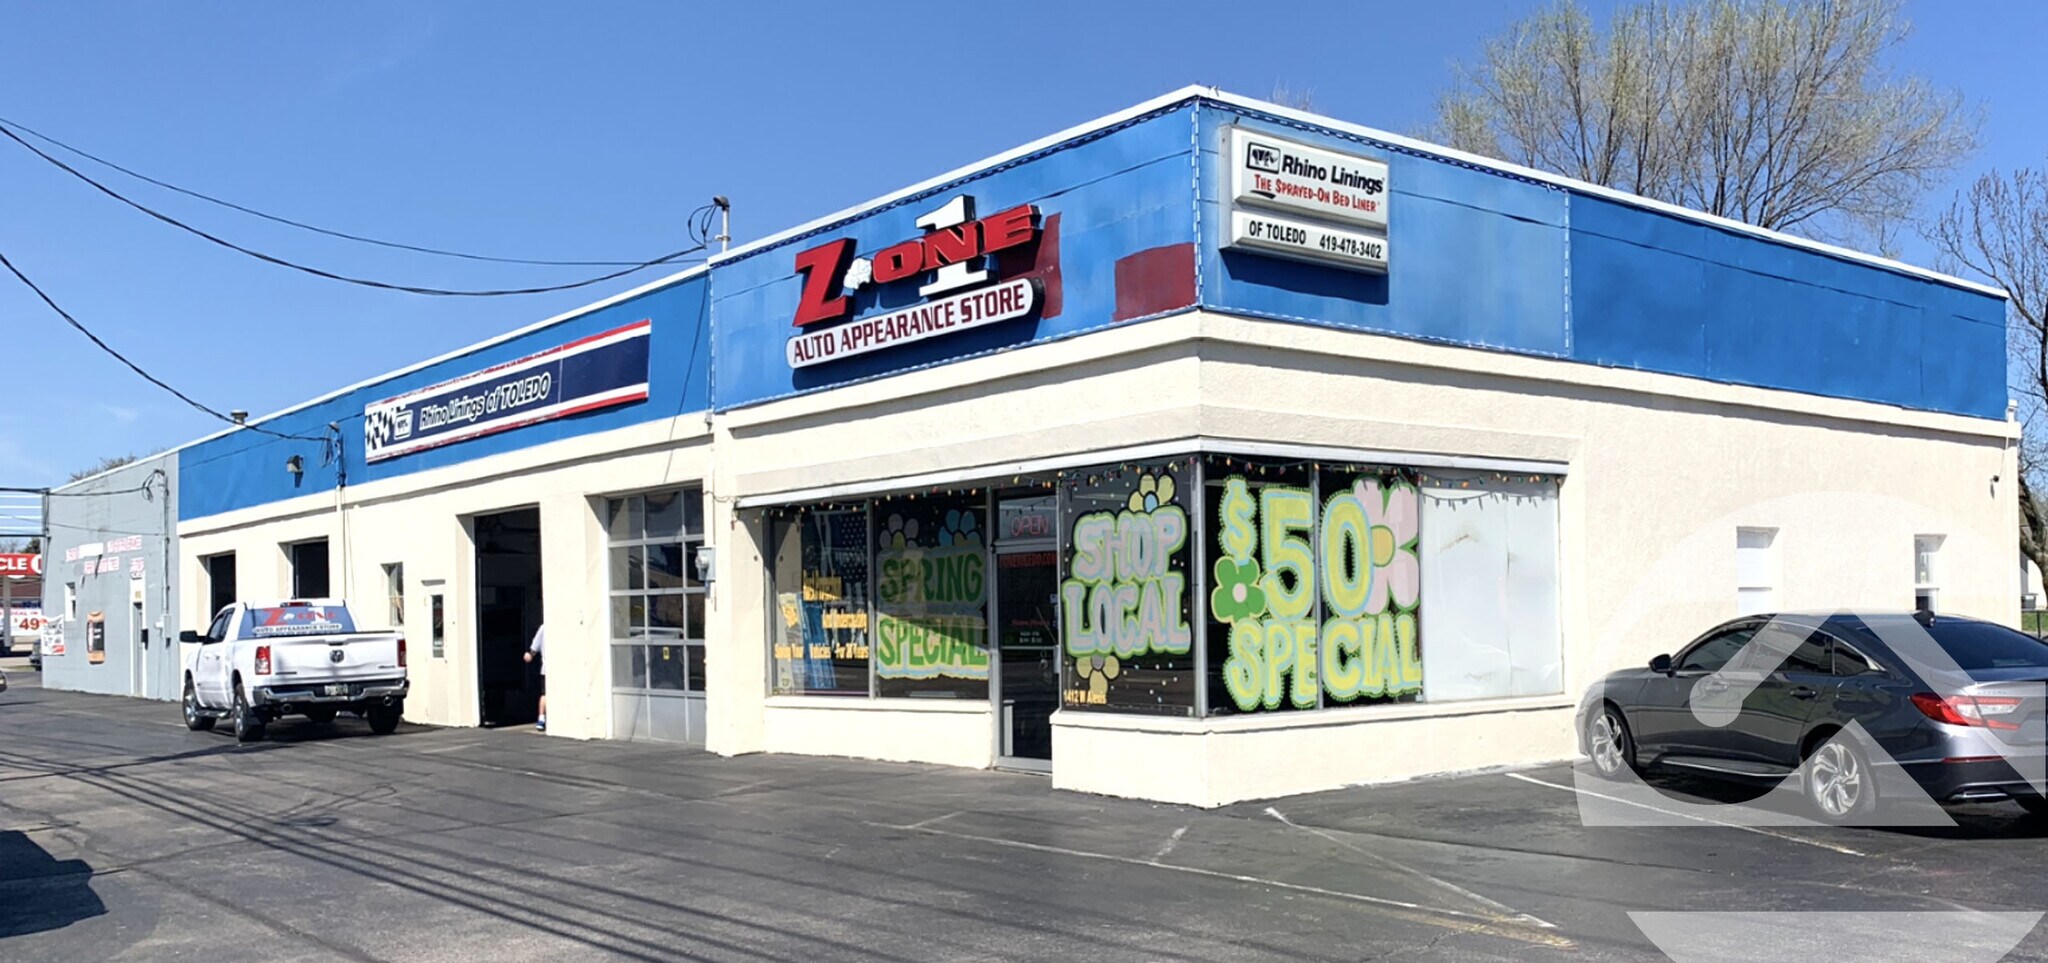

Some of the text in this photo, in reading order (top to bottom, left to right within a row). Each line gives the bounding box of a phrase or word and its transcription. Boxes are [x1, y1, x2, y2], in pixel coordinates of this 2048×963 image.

[1255, 174, 1377, 212] THE SPRAYED-ON BED LINER
[1282, 155, 1384, 195] Rhino Linings
[1249, 220, 1382, 260] OF TOLEDO 419-478-3402
[793, 283, 1025, 363] AUTO APPEARANCE STORE
[419, 372, 551, 431] Rhino Linings of TOLEDO
[1011, 515, 1049, 537] OPEN
[1072, 505, 1187, 583] SHOP
[1218, 474, 1376, 621] $50
[879, 552, 986, 606] SPRING
[1062, 571, 1192, 657] LOCAL
[876, 617, 988, 670] SPECIAL
[1223, 613, 1422, 713] SPECIAL
[1063, 689, 1079, 703] 1412
[1079, 690, 1086, 703] W
